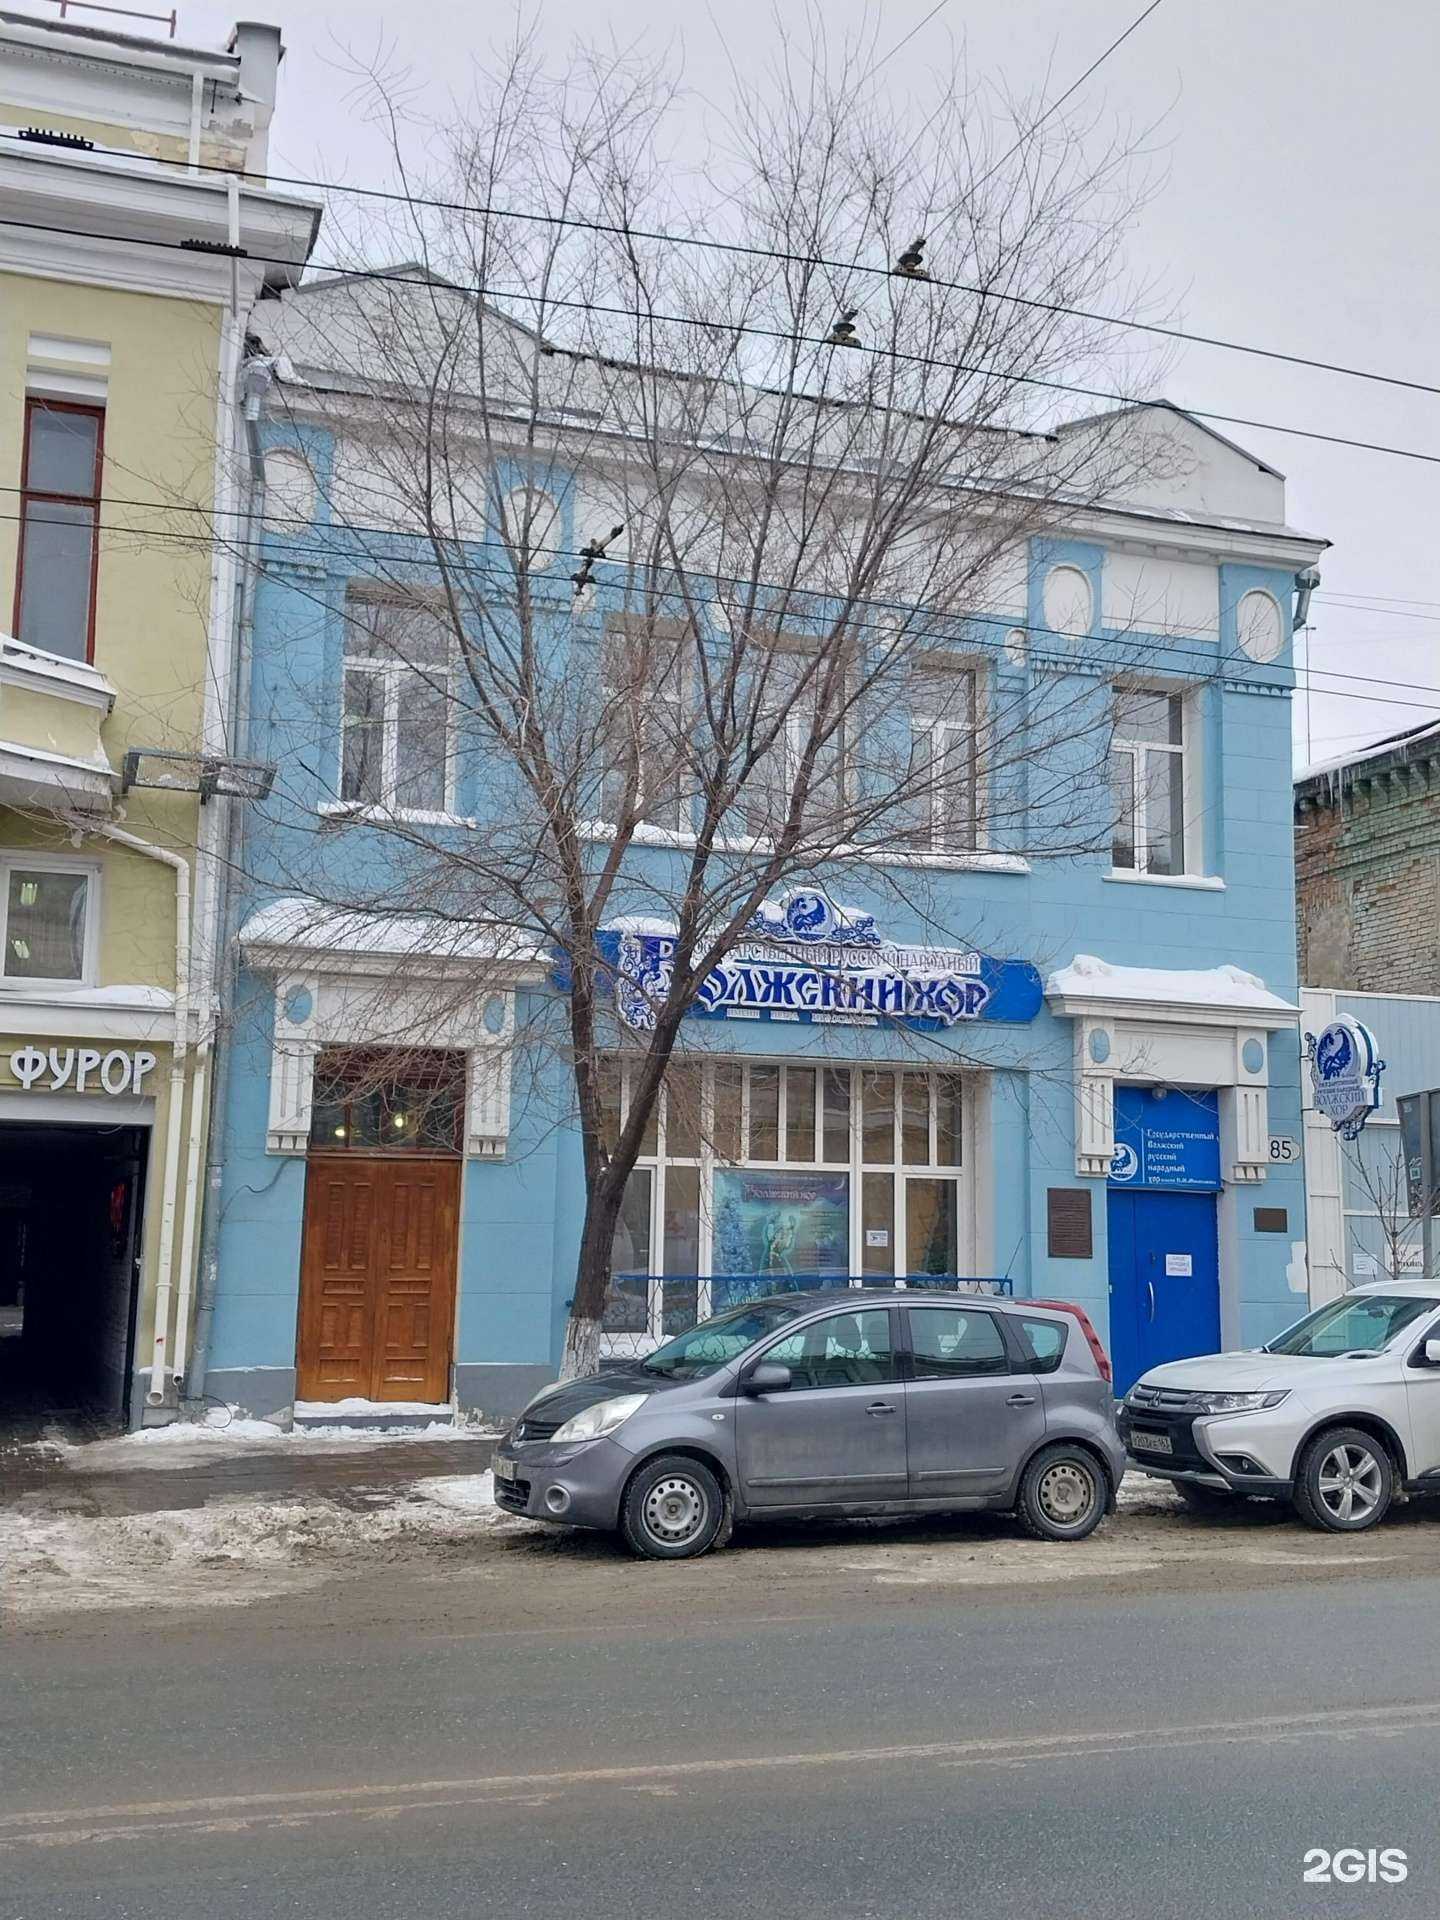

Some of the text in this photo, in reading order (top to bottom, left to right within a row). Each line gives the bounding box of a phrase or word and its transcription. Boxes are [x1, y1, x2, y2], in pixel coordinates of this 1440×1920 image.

[900, 953, 979, 972] НАРОДНЫЙ
[10, 1045, 156, 1095] ФУРОР
[1270, 1140, 1292, 1160] 85
